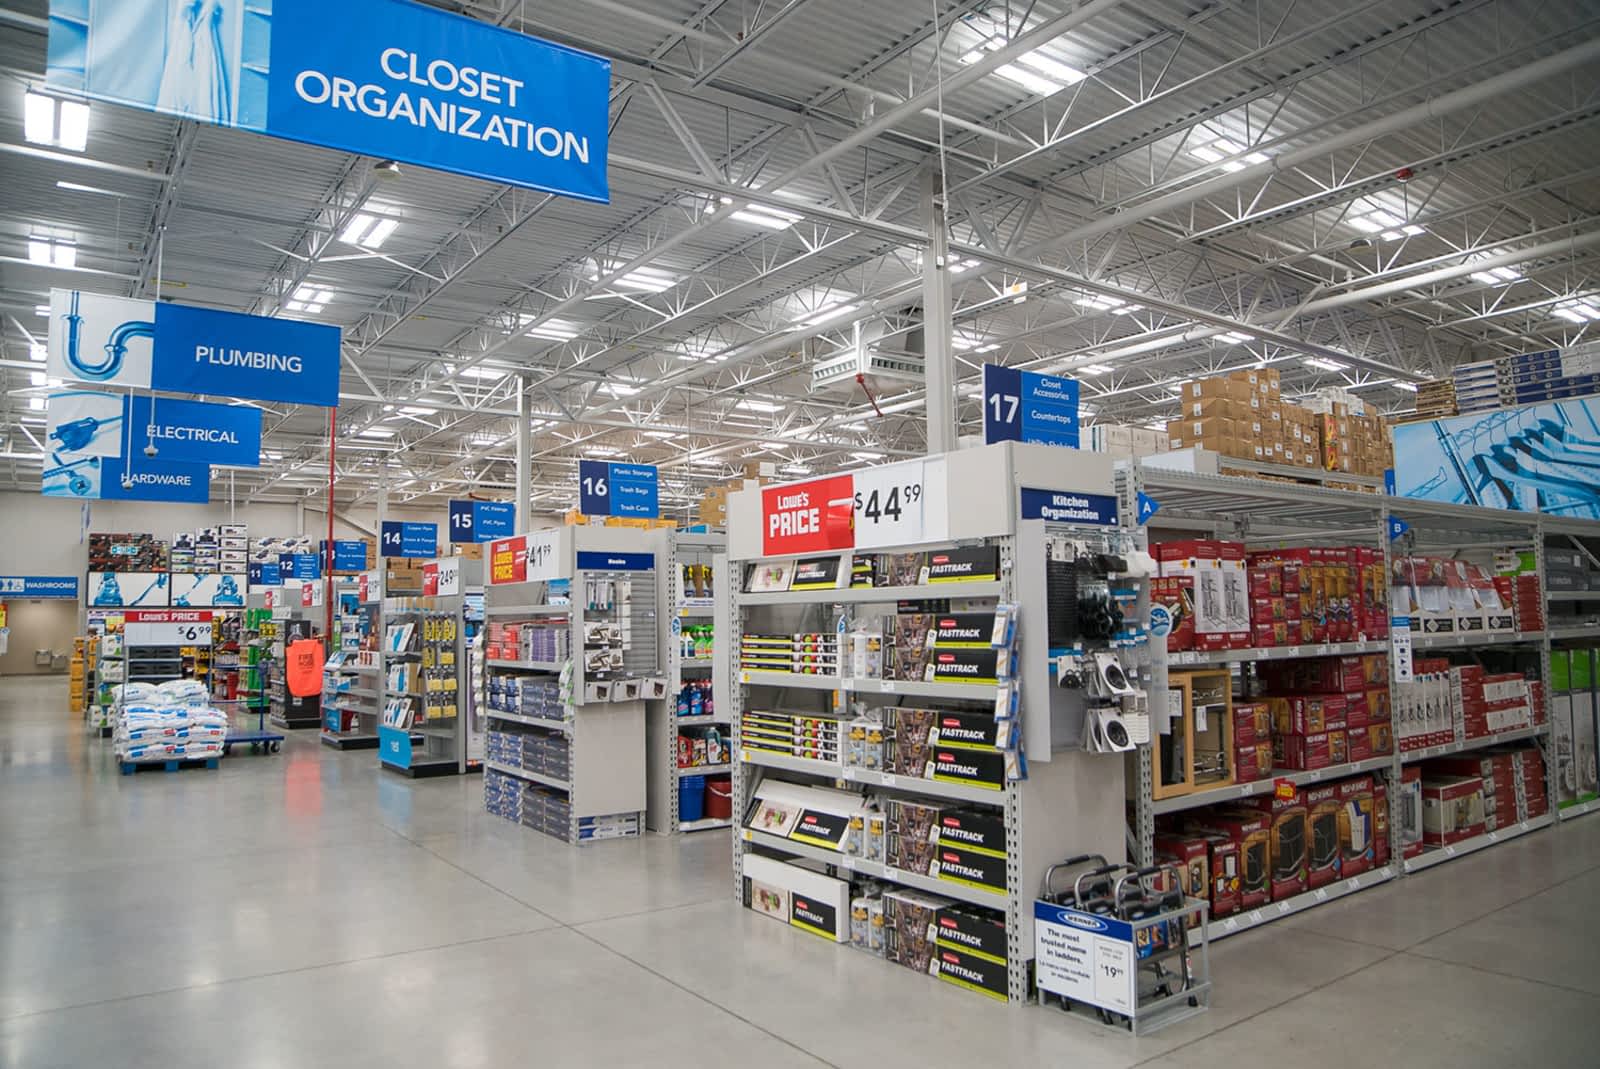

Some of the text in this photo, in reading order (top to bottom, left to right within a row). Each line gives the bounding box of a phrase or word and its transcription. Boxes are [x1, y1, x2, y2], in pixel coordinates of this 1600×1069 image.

[380, 48, 524, 107] CLOSET
[294, 70, 590, 164] ORGANIZATION
[195, 346, 303, 373] PLUMBING
[1041, 378, 1061, 390] Closet
[1033, 387, 1070, 401] Accessories
[989, 393, 1020, 424] 17
[1031, 410, 1072, 424] Countertops
[147, 424, 239, 444] ELECTRICAL
[121, 472, 192, 487] HARDWARE
[632, 469, 653, 478] Storage
[583, 477, 608, 496] 16
[635, 487, 649, 495] Bags
[1053, 495, 1089, 508] Kitchen
[1143, 501, 1152, 513] A
[452, 513, 472, 528] 15
[1041, 506, 1099, 521] Organization
[769, 508, 820, 538] PRICE
[1394, 523, 1402, 533] B
[383, 532, 401, 545] 14
[280, 561, 293, 570] 12
[931, 563, 972, 575] FASTTRACK
[250, 569, 261, 578] 11
[171, 612, 200, 621] PRICE
[938, 628, 980, 639] FASTTRACK
[937, 663, 979, 674] FASTTRACK
[941, 727, 985, 740] FASTTRACK
[936, 762, 978, 776] FASTTRACK
[942, 826, 984, 843] FASTTRACK
[942, 861, 984, 879] FASTTRACK
[1067, 915, 1099, 928] WERNER
[939, 926, 982, 947] FASTTRACK
[1047, 928, 1080, 943] The most
[1040, 936, 1066, 949] trusted
[1066, 943, 1087, 955] name
[1054, 951, 1083, 964] ladders.
[942, 961, 984, 983] FASTTRACK
